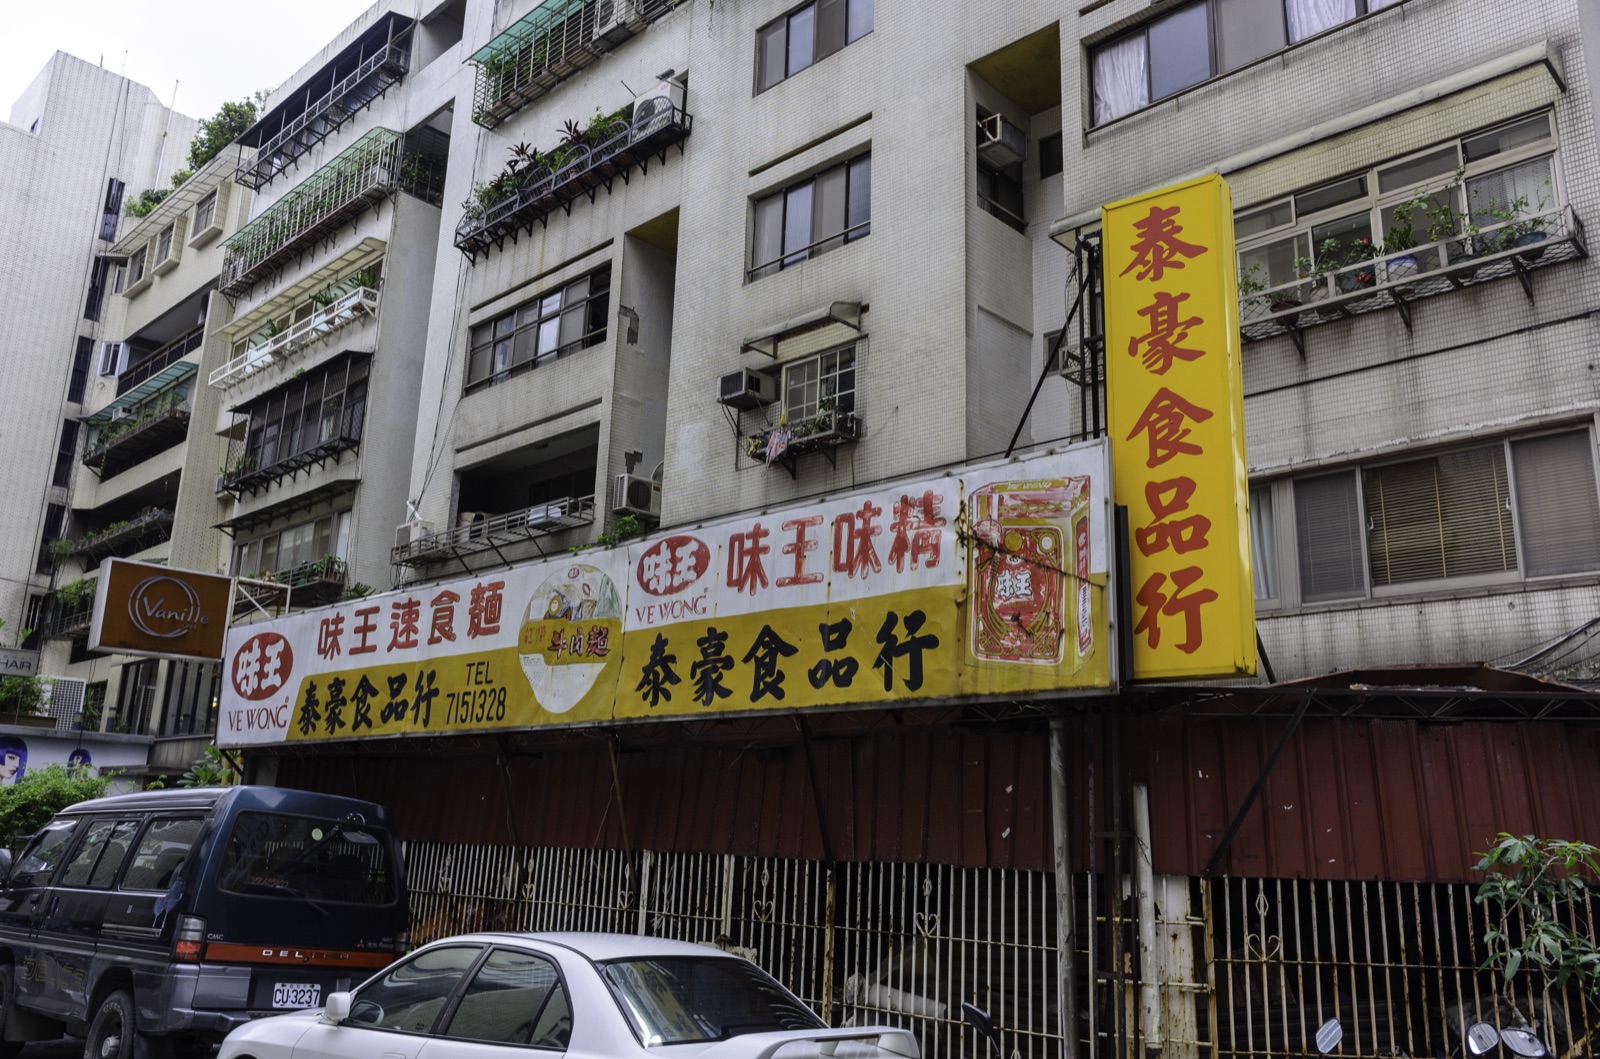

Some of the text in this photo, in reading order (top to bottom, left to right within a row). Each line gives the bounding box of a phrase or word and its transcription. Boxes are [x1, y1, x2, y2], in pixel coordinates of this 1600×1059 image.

[1118, 205, 1218, 655] 泰豪食品行
[725, 489, 947, 597] 味王味精
[643, 539, 705, 590] 味王
[996, 569, 1033, 599] 味王
[143, 596, 209, 624] Vanille
[317, 580, 506, 661] 味王速食麵
[635, 593, 708, 625] VE WONG
[236, 638, 285, 696] 味王
[465, 661, 494, 685] TEL
[634, 609, 940, 708] 泰豪食品行
[228, 704, 288, 731] VE WONG
[297, 669, 440, 736] 泰豪食品行
[446, 686, 508, 726] 7151328
[262, 949, 349, 960] DELICA
[274, 988, 320, 1005] CU-3237
